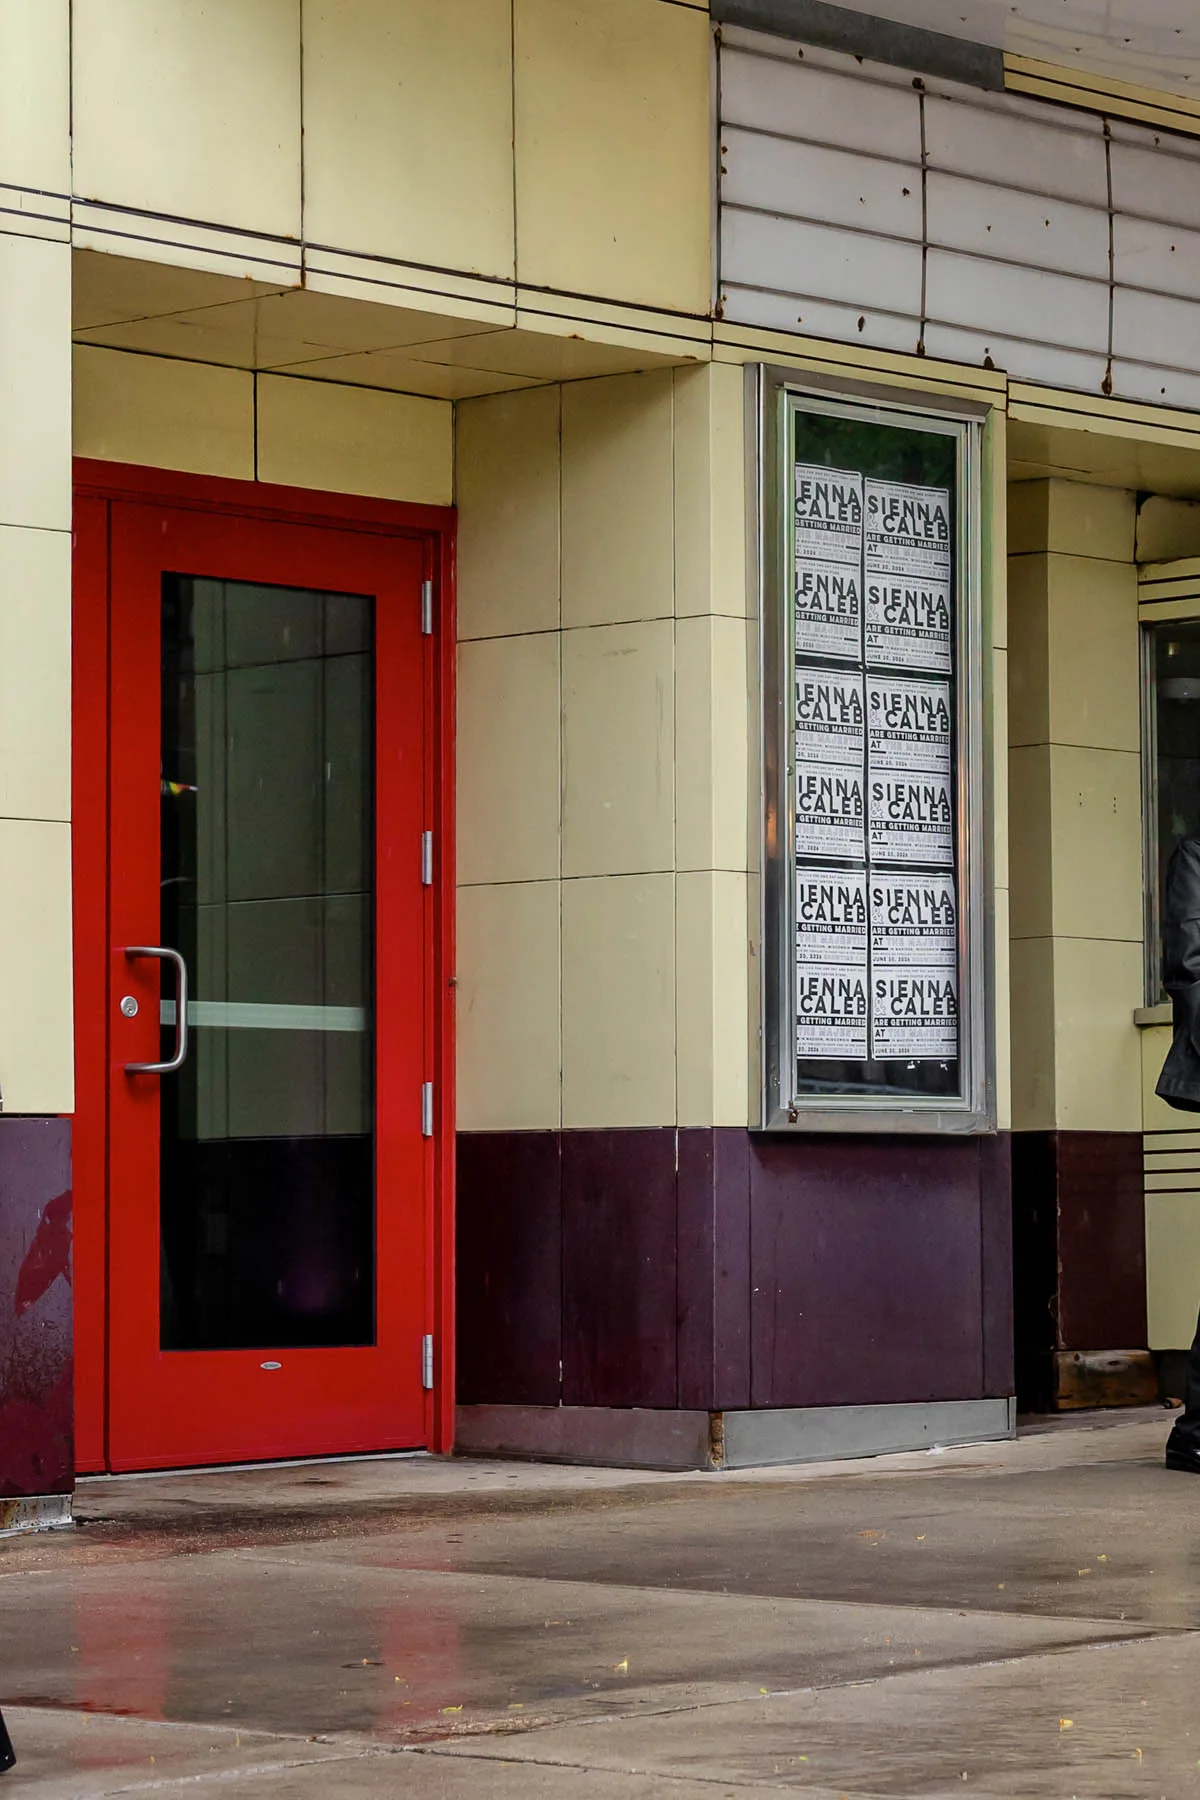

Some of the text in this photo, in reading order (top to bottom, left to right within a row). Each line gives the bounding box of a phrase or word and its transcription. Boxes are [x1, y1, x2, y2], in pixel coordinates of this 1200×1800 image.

[795, 481, 860, 507] ENNA
[795, 497, 862, 523] CALEB
[867, 495, 947, 525] SIENNA
[795, 519, 829, 530] GETTING
[883, 515, 948, 540] CALEB
[866, 533, 881, 543] ARE
[884, 534, 916, 547] GETTING
[867, 544, 878, 552] AT
[795, 572, 858, 599] IENNA
[795, 590, 858, 614] CALEB
[869, 586, 948, 614] SIENNA
[795, 612, 827, 621] GETTING
[884, 605, 948, 629] CALEB
[866, 624, 882, 633] ARE
[884, 627, 916, 637] GETTING
[867, 635, 878, 643] AT
[796, 683, 860, 708] IENNA
[870, 692, 948, 716] SIENNA
[797, 700, 862, 724] CALEB
[885, 710, 949, 732] CALEB
[798, 722, 830, 732] GETTING
[870, 730, 885, 739] ARE
[887, 732, 919, 742] GETTING
[870, 741, 881, 749] AT
[798, 775, 861, 799] IENNA
[872, 783, 950, 807] SIENNA
[799, 793, 862, 816] CALEB
[888, 801, 950, 822] CALEB
[800, 815, 832, 825] GETTING
[870, 821, 886, 830] ARE
[889, 823, 920, 832] GETTING
[871, 832, 883, 840] AT
[800, 884, 864, 907] IENNA
[873, 888, 953, 908] SIENNA
[801, 902, 866, 923] CALEB
[888, 906, 955, 925] CALEB
[802, 924, 832, 932] GETTING
[873, 938, 884, 946] AT
[800, 977, 865, 998] IENNA
[876, 980, 955, 998] SIENNA
[800, 995, 866, 1016] CALEB
[891, 997, 957, 1016] CALEB
[801, 1017, 832, 1025] GETTING
[875, 1029, 885, 1037] AT
